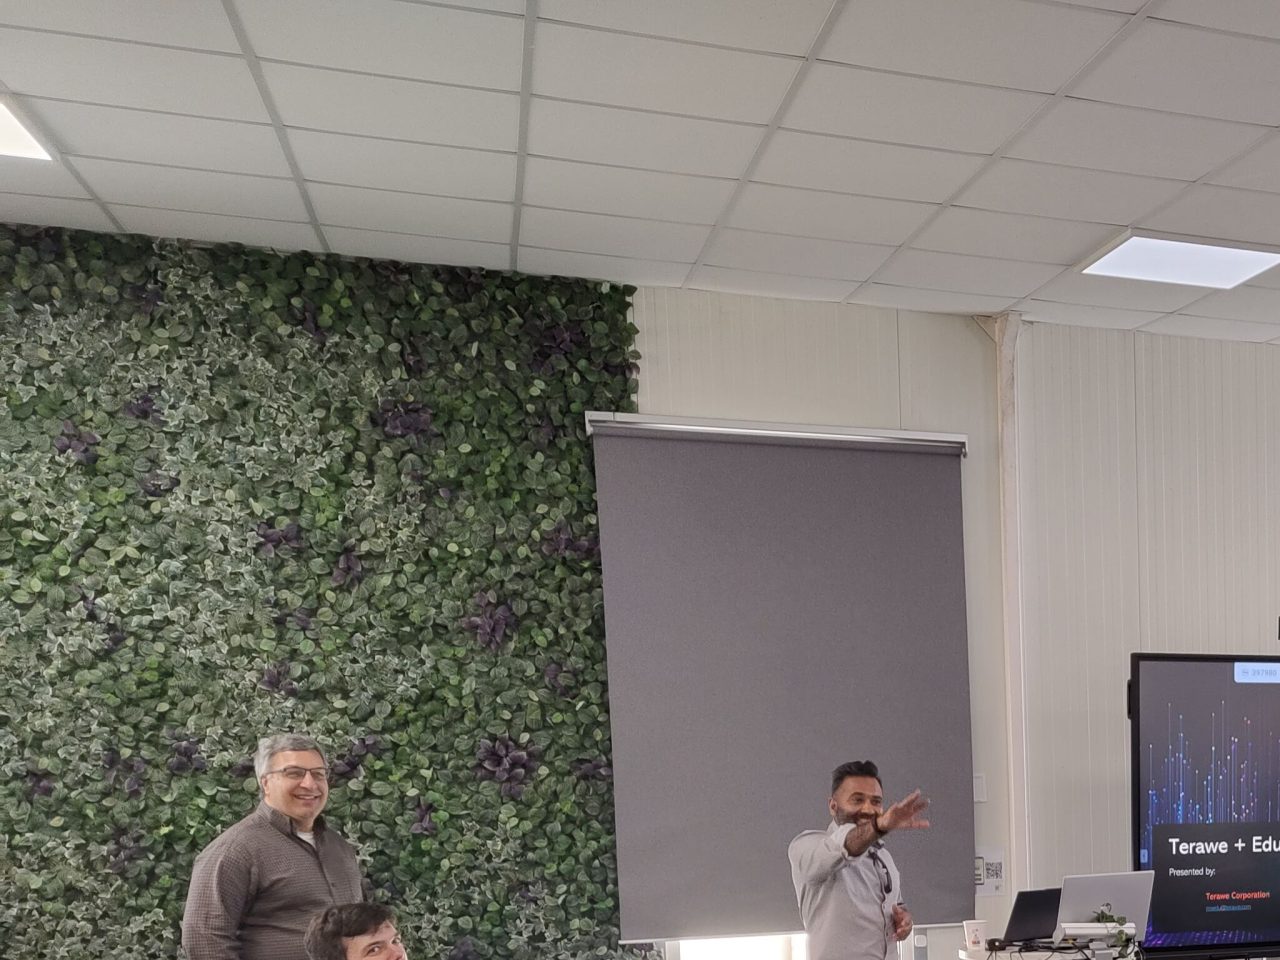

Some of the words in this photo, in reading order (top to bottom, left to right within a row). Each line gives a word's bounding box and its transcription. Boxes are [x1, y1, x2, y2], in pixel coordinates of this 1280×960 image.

[1168, 838, 1228, 855] Terawe
[1234, 838, 1246, 852] +
[1168, 867, 1204, 876] Presented
[1206, 866, 1216, 878] by:
[1206, 892, 1230, 900] Terawe
[1231, 890, 1270, 900] Corporation
